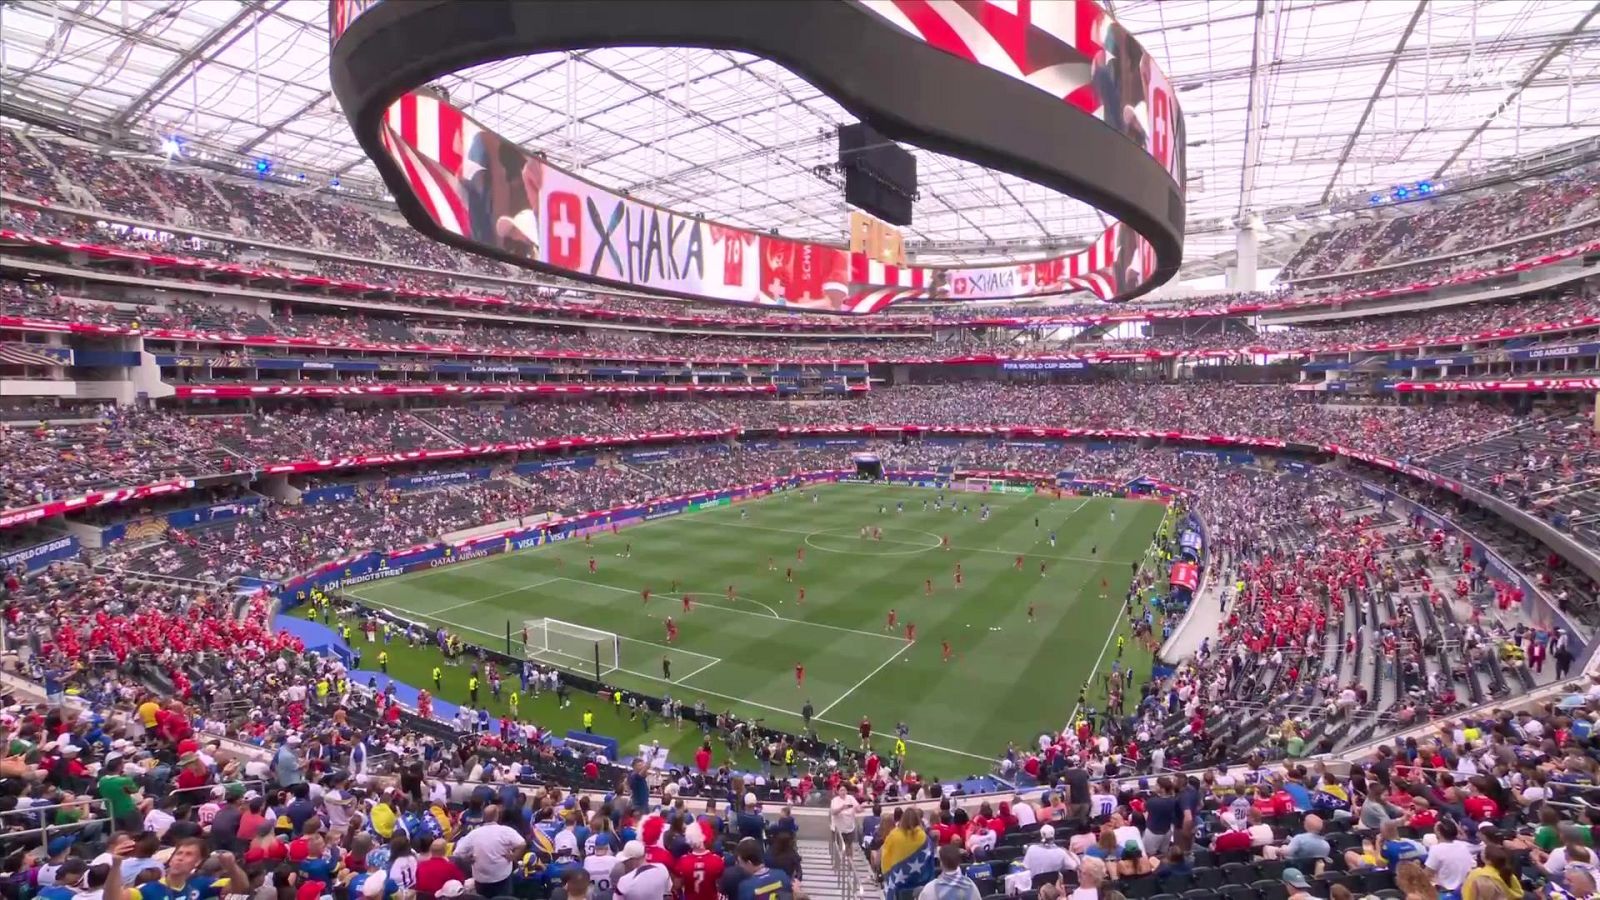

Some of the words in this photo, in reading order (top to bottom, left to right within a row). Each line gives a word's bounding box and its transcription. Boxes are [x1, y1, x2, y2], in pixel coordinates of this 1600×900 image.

[587, 196, 704, 283] XHAKA
[727, 240, 740, 265] 10
[969, 271, 1015, 294] XHAKA
[1544, 347, 1579, 356] ANGELES
[518, 539, 535, 549] VISA
[550, 533, 565, 543] VISA
[8, 550, 35, 565] WORLD
[35, 545, 49, 556] CUP
[49, 537, 71, 552] 2026
[430, 556, 456, 568] QATAR
[458, 549, 488, 561] AIRWAYS
[323, 580, 339, 593] ADI
[693, 870, 705, 893] 7
